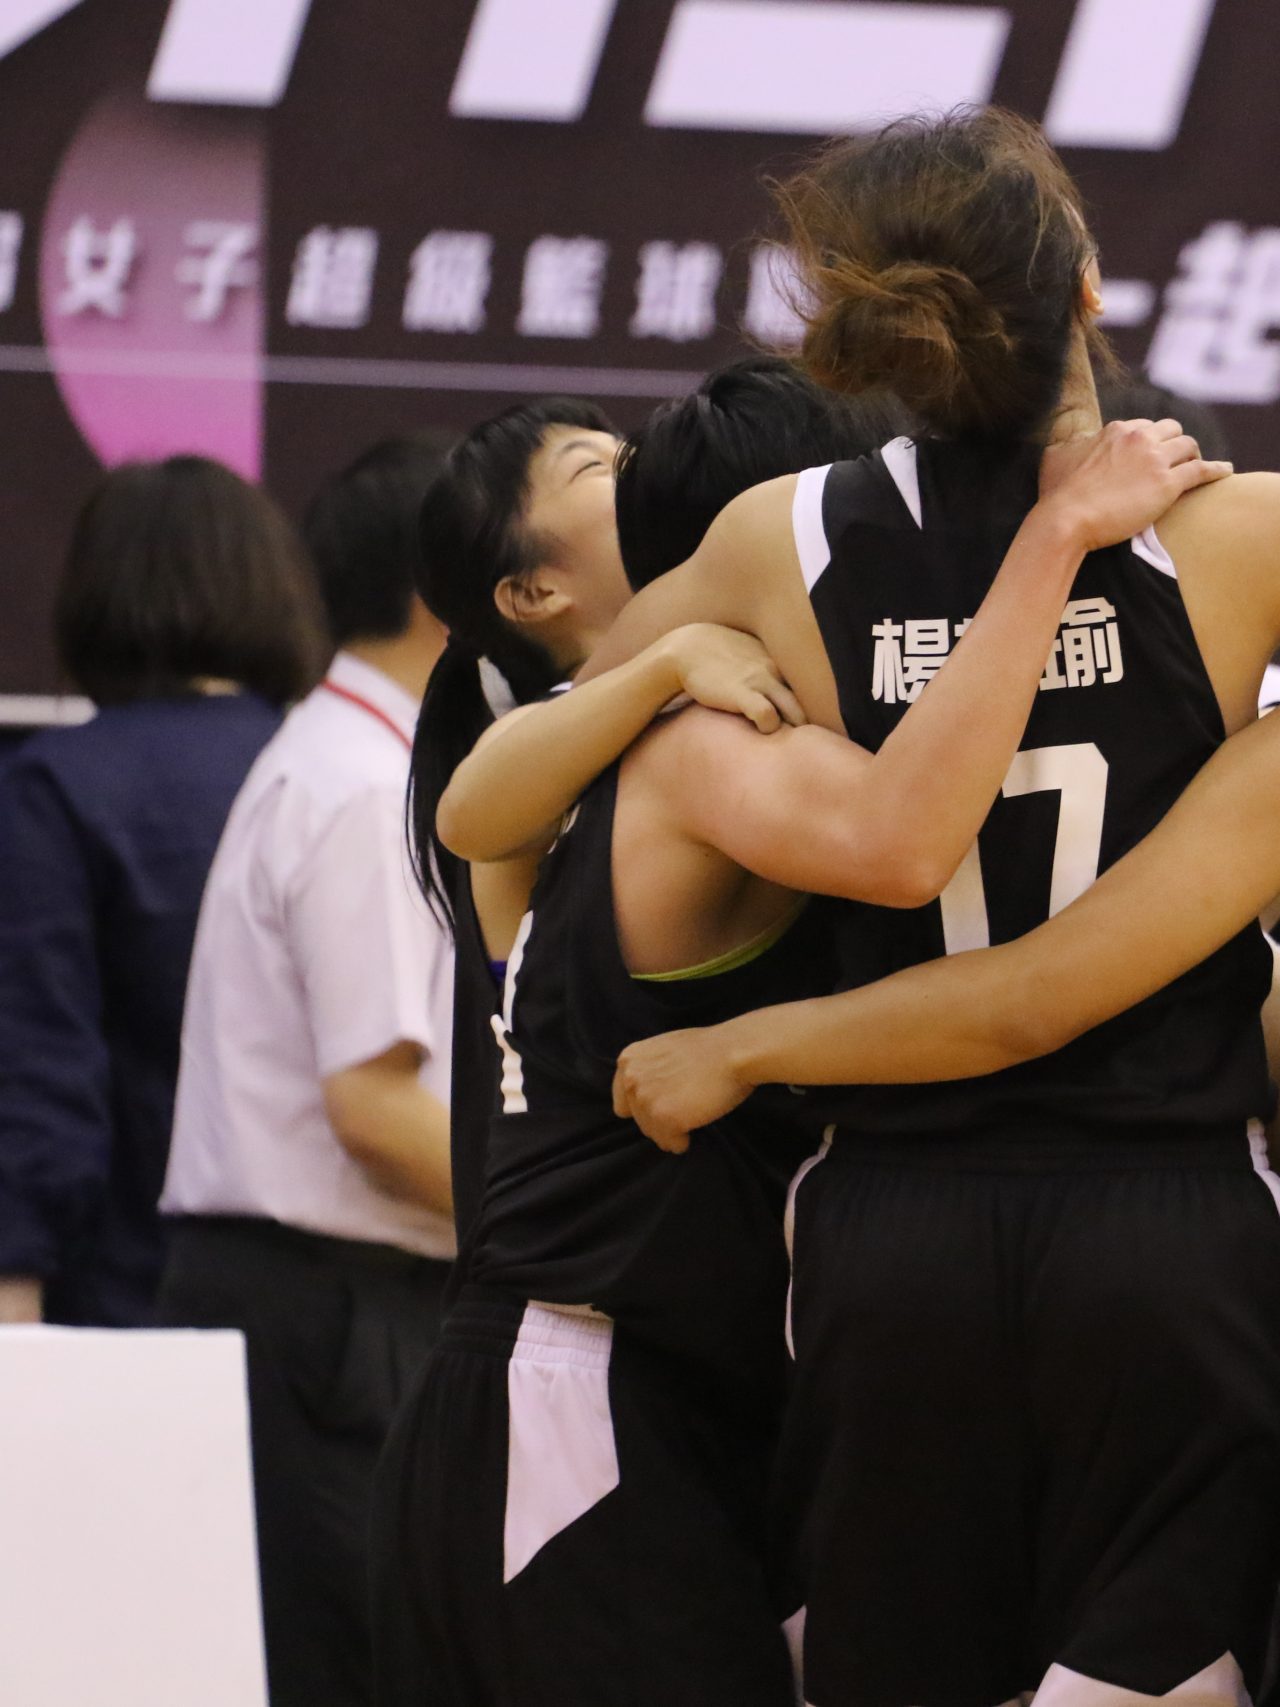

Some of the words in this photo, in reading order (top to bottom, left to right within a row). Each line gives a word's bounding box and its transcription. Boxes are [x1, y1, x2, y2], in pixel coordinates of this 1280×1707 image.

[0, 210, 820, 347] 女子超級籃球
[871, 597, 1124, 704] 楊瑜
